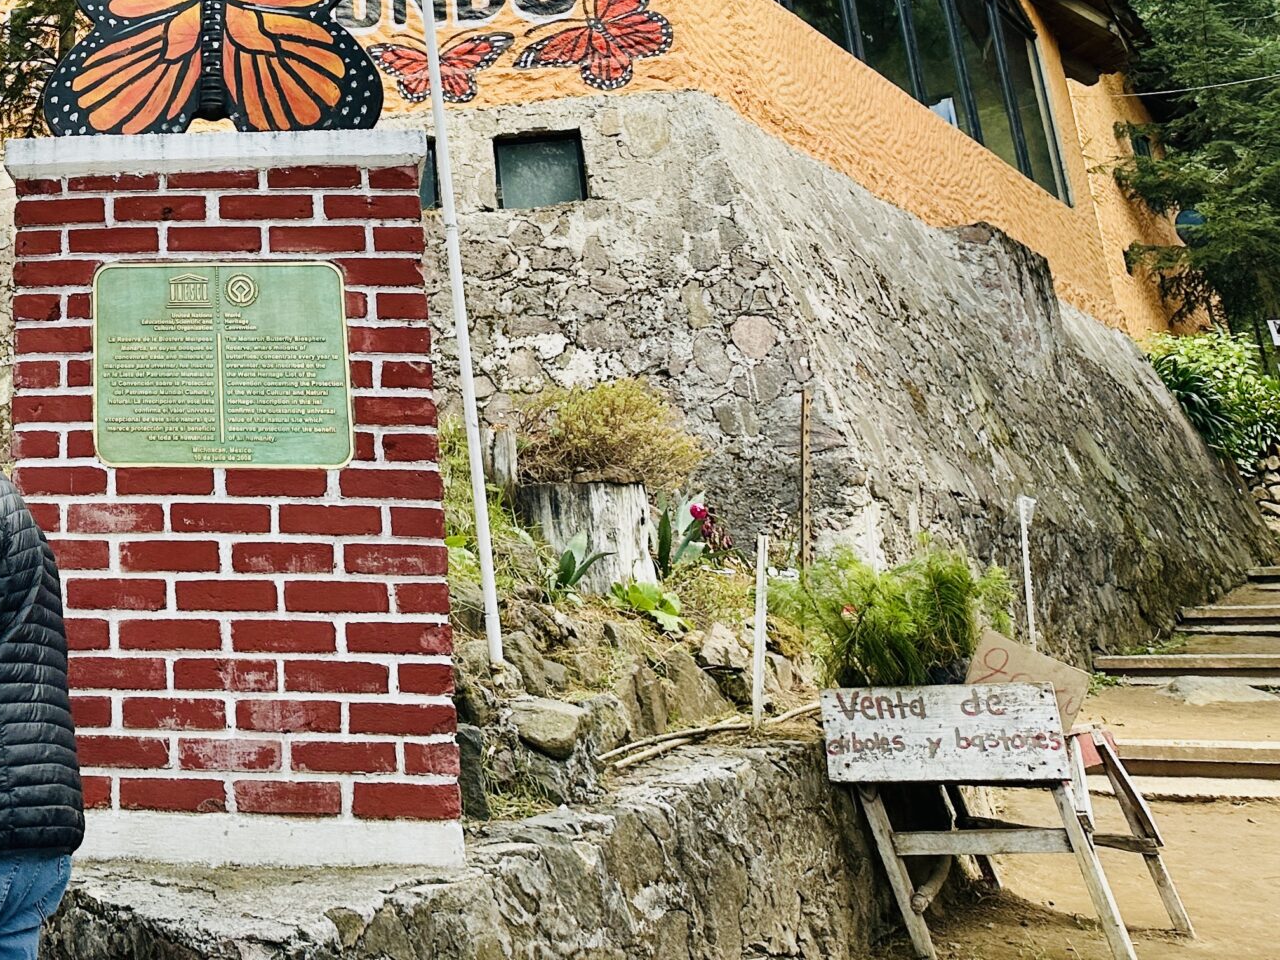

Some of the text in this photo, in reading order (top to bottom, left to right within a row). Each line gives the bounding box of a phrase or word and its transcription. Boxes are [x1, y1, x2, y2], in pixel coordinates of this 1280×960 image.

[835, 688, 1007, 720] Venta de
[926, 737, 941, 759] y
[954, 727, 1062, 752] bastones
